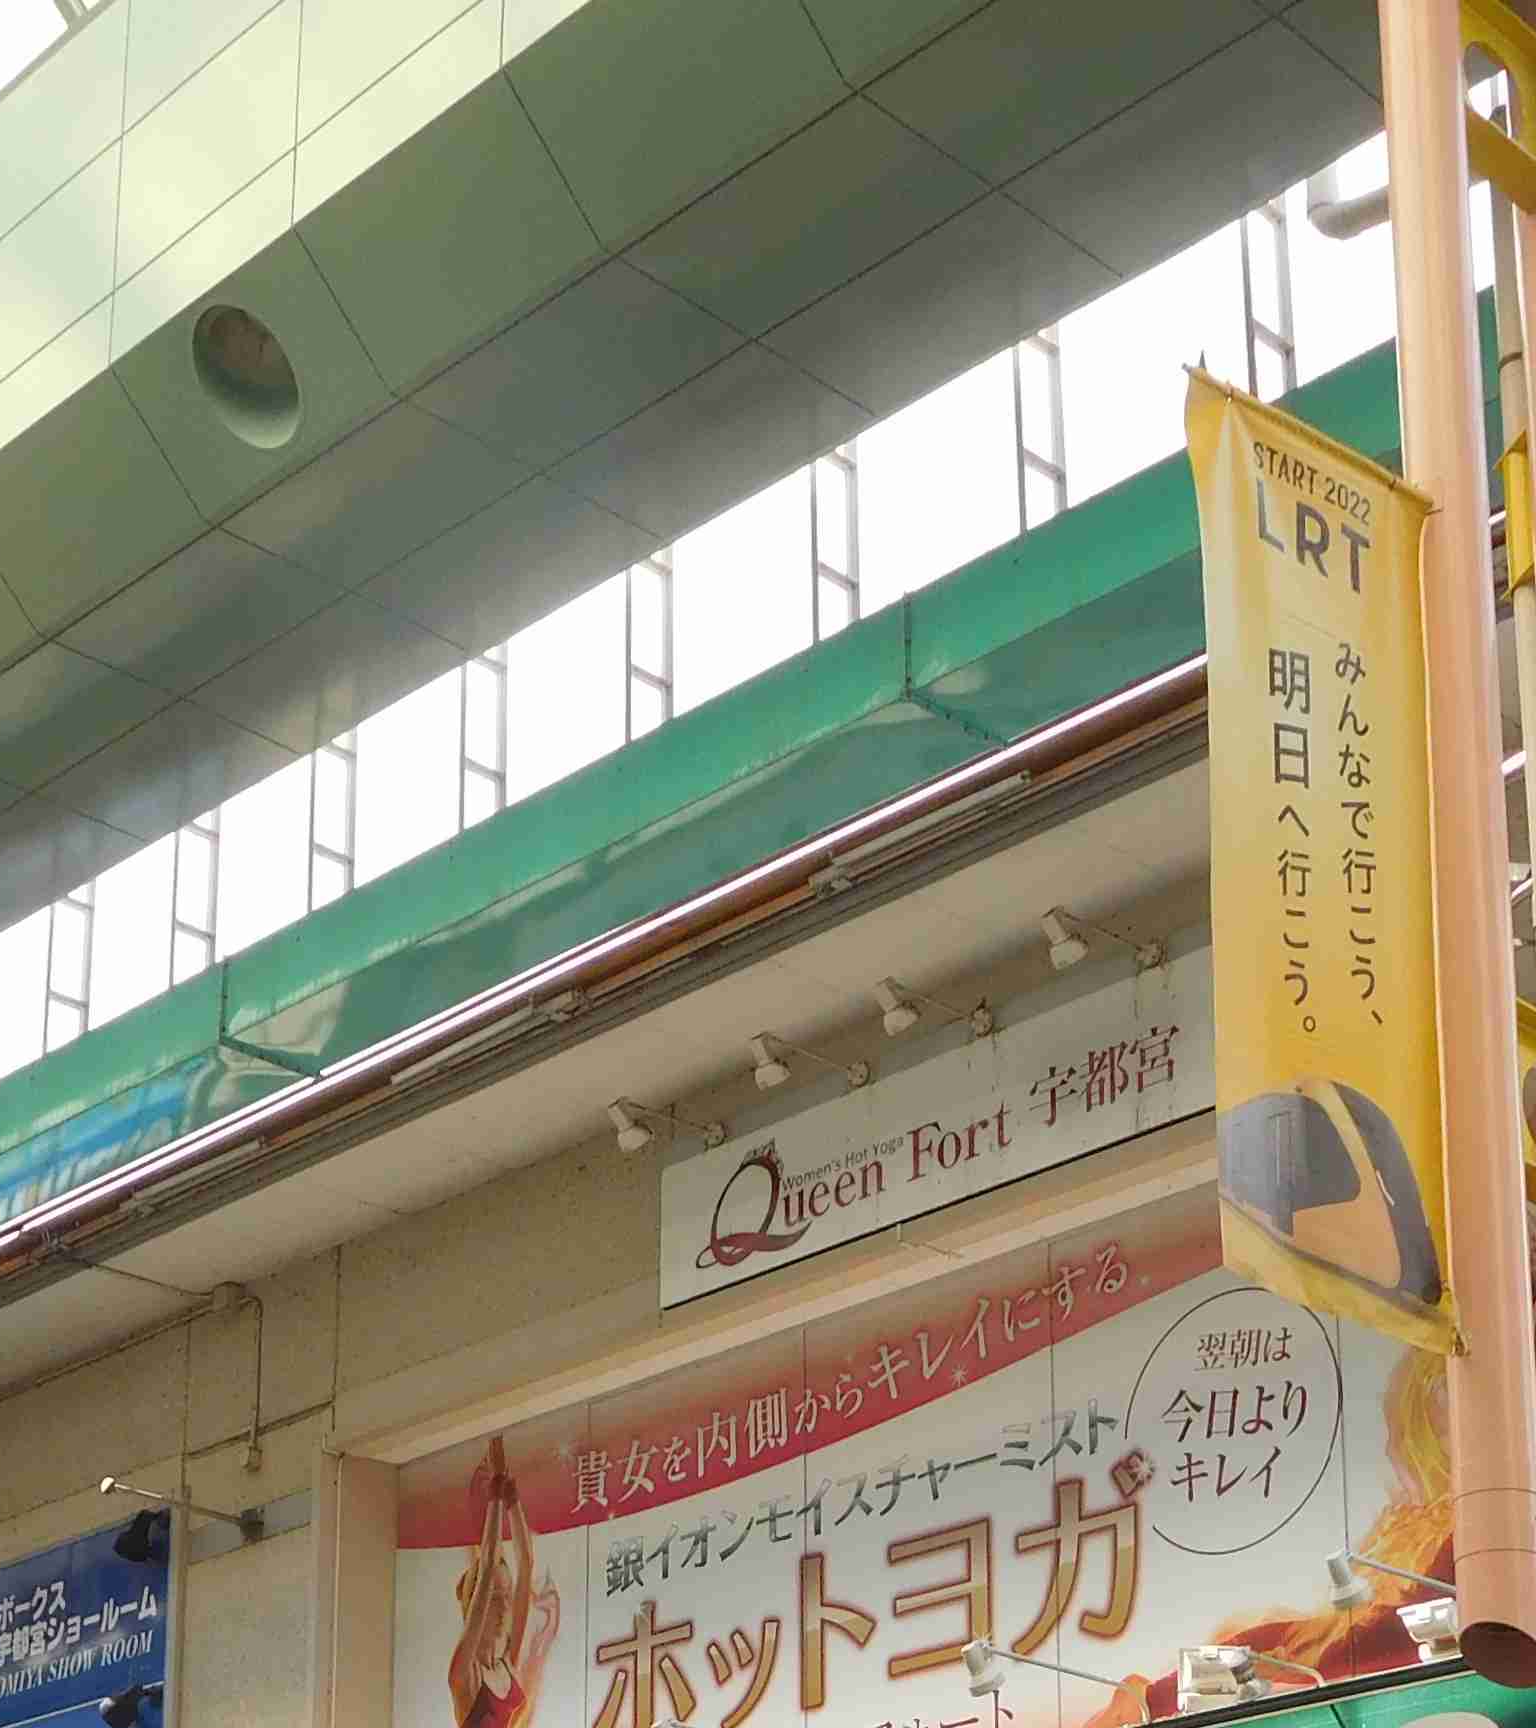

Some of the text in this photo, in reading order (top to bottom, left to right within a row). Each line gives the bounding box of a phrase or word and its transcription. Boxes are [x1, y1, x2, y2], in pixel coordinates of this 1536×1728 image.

[1253, 441, 1371, 526] START 2022
[1256, 477, 1371, 595] LRT
[1268, 648, 1317, 1034] 明日へ行こう。
[1334, 641, 1384, 1027] みんなで行こう、
[695, 1025, 1180, 1270] Queen Fort 宇都宮
[783, 1136, 904, 1190] Women's Hot Yoga
[1194, 1325, 1292, 1373] 翌朝は
[1161, 1378, 1309, 1443] 今日より
[605, 1399, 1120, 1598] 銀イオンモイスチャーミスト
[1169, 1446, 1282, 1504] キレイ
[48, 1648, 97, 1681] SHOW
[100, 1630, 154, 1666] ROOM
